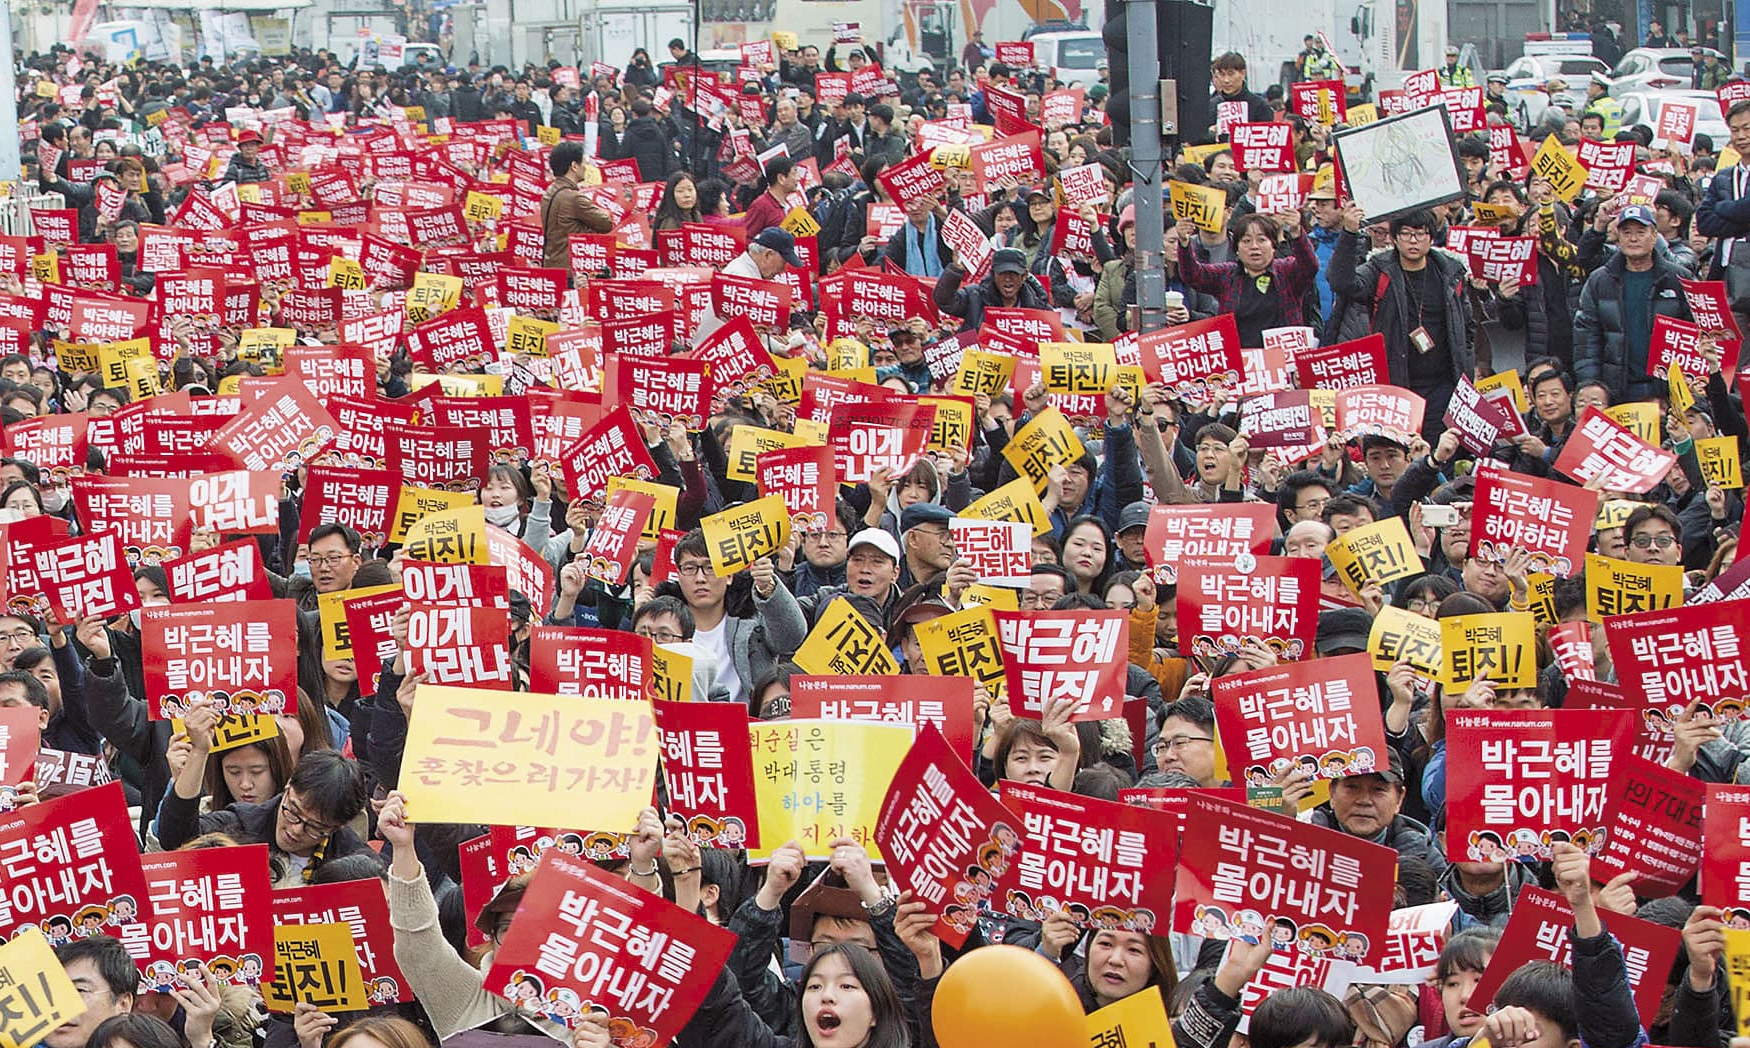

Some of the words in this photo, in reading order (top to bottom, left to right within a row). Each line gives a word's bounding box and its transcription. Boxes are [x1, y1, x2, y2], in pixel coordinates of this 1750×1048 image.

[1235, 127, 1292, 147] 박근혜
[1580, 144, 1633, 165] 박근혜
[1242, 148, 1282, 169] 퇴진
[1471, 238, 1536, 263] 박근혜
[1482, 262, 1523, 282] 퇴진
[1155, 331, 1224, 359] 박근혜를
[633, 367, 701, 391] 박근혜를
[1049, 364, 1113, 393] 퇴진!
[1159, 356, 1227, 383] 몰아내자
[632, 389, 699, 411] 몰아내자
[729, 512, 764, 530] 박근혜
[1490, 487, 1573, 527] 박근혜는
[719, 519, 780, 568] 퇴진!
[952, 526, 1013, 550] 박근혜
[1486, 514, 1568, 553] 하야하라
[164, 624, 272, 653] 박근혜를
[407, 610, 472, 647] 이게
[1000, 619, 1123, 664] 박근혜
[1466, 627, 1502, 644] 박근혜
[1632, 626, 1740, 667] 박근혜를
[165, 656, 272, 690] 몰아내자
[1451, 646, 1521, 683] 퇴진!
[1642, 660, 1748, 703] 몰아내자
[1491, 720, 1553, 730] www.nanum.com
[1481, 739, 1613, 780] 박근혜를
[1480, 783, 1607, 825] 몰아내자
[1024, 812, 1146, 866] 박근혜를
[1218, 824, 1363, 888] 박근혜를
[1018, 853, 1144, 904] 몰아내자
[1211, 862, 1358, 920] 몰아내자
[277, 940, 320, 960] 박근혜
[559, 890, 697, 983] 박근혜를
[270, 960, 347, 1008] 퇴진!
[538, 933, 673, 1023] 몰아내자
